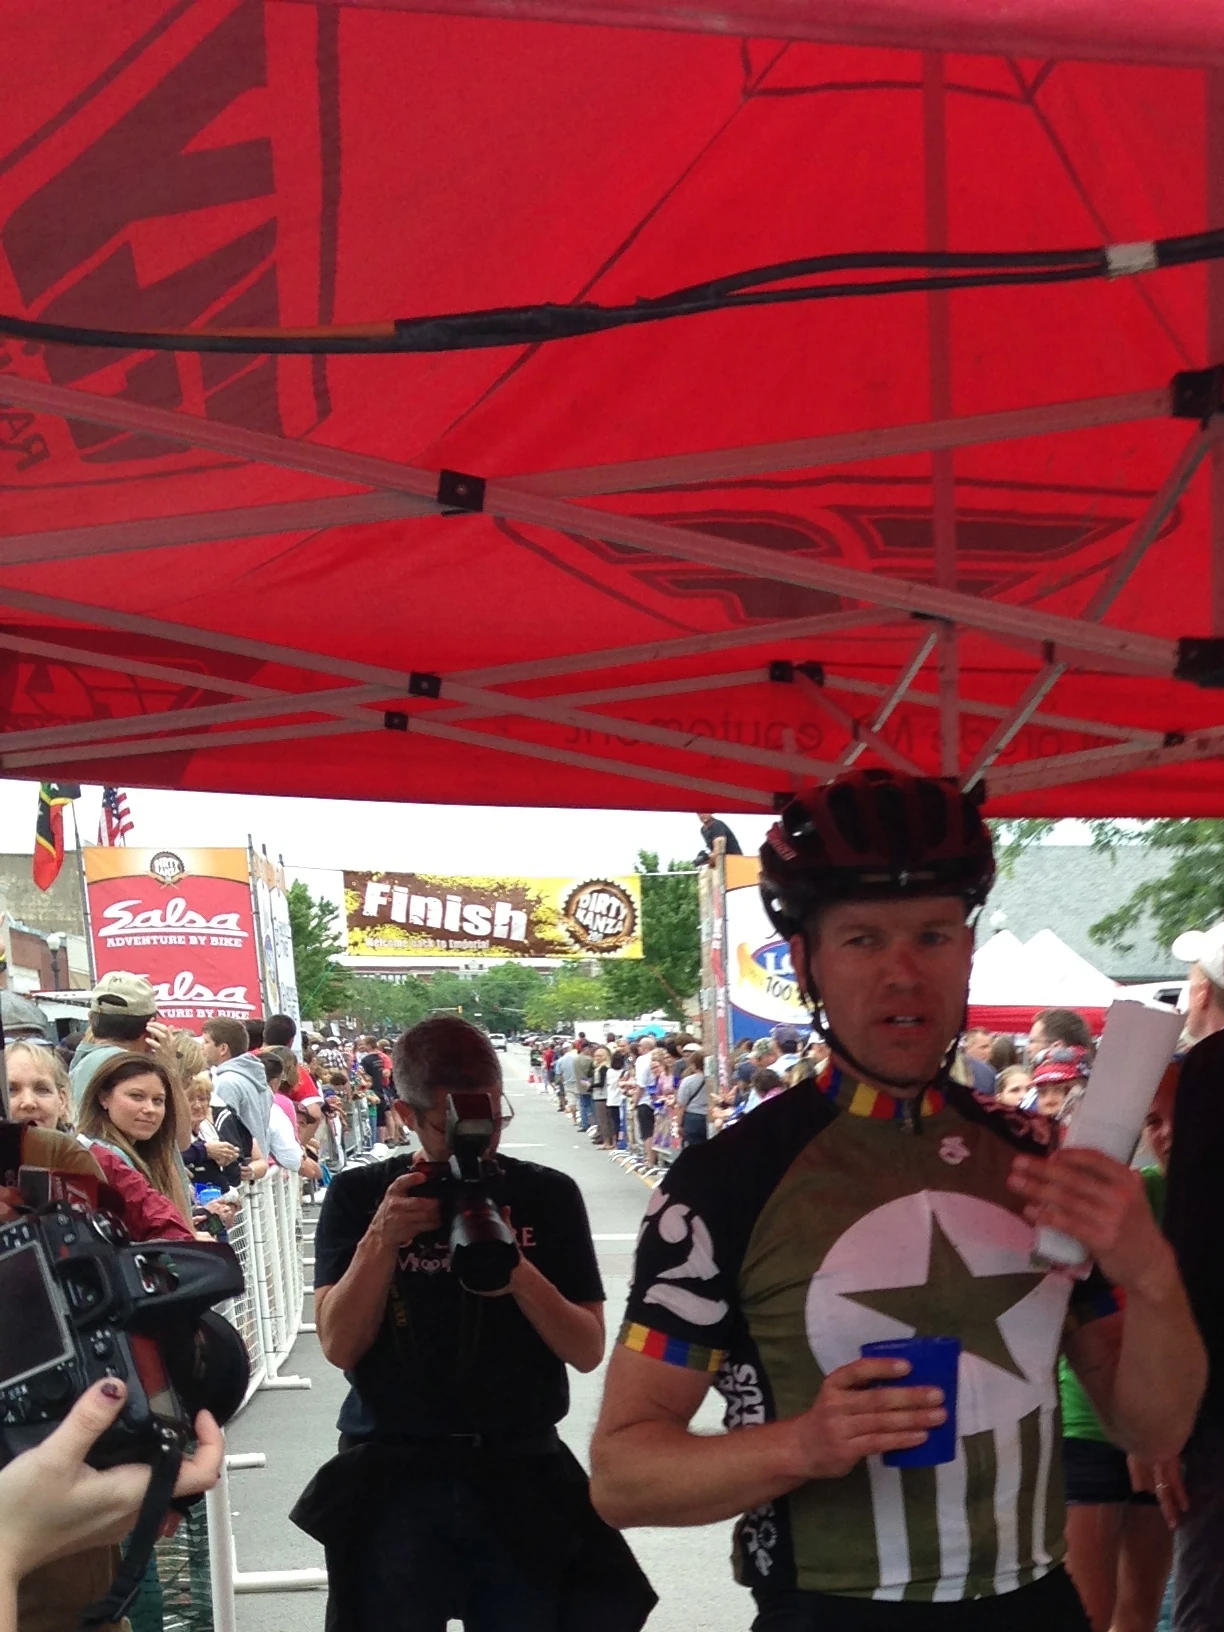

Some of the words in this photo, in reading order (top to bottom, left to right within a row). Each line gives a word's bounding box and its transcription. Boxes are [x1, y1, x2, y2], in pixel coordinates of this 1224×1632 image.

[97, 897, 248, 937] Salsa
[362, 881, 528, 941] Finish
[578, 893, 628, 920] DIRTY
[575, 907, 624, 934] KANZA
[106, 936, 186, 947] ADVENTURE
[189, 936, 207, 946] BY
[210, 937, 243, 947] BIKE
[196, 1009, 215, 1019] BY
